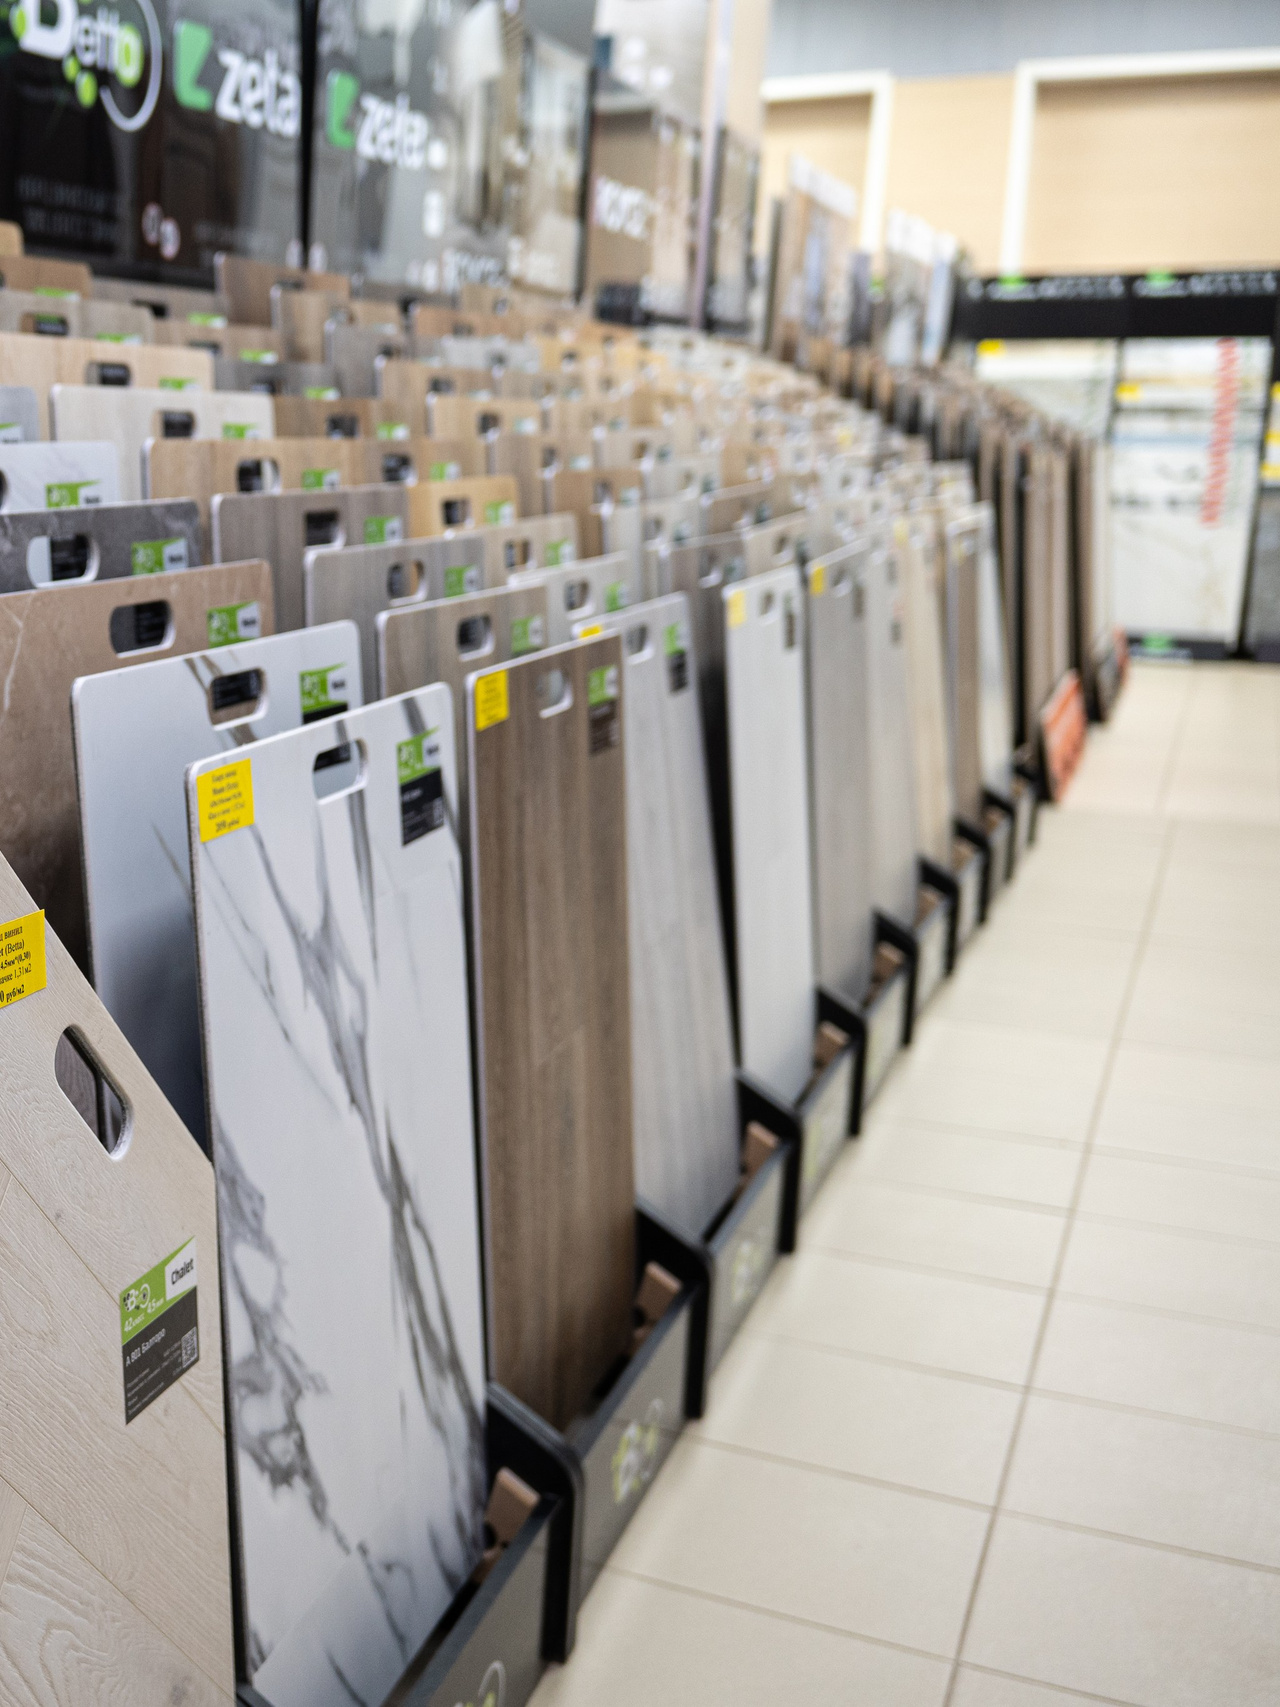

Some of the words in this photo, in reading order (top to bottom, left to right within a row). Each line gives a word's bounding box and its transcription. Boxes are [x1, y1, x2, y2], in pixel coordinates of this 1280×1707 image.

[4, 926, 23, 939] винил
[4, 939, 25, 957] (Betta)
[5, 984, 25, 1003] руб/м2
[171, 1258, 194, 1285] Chalet
